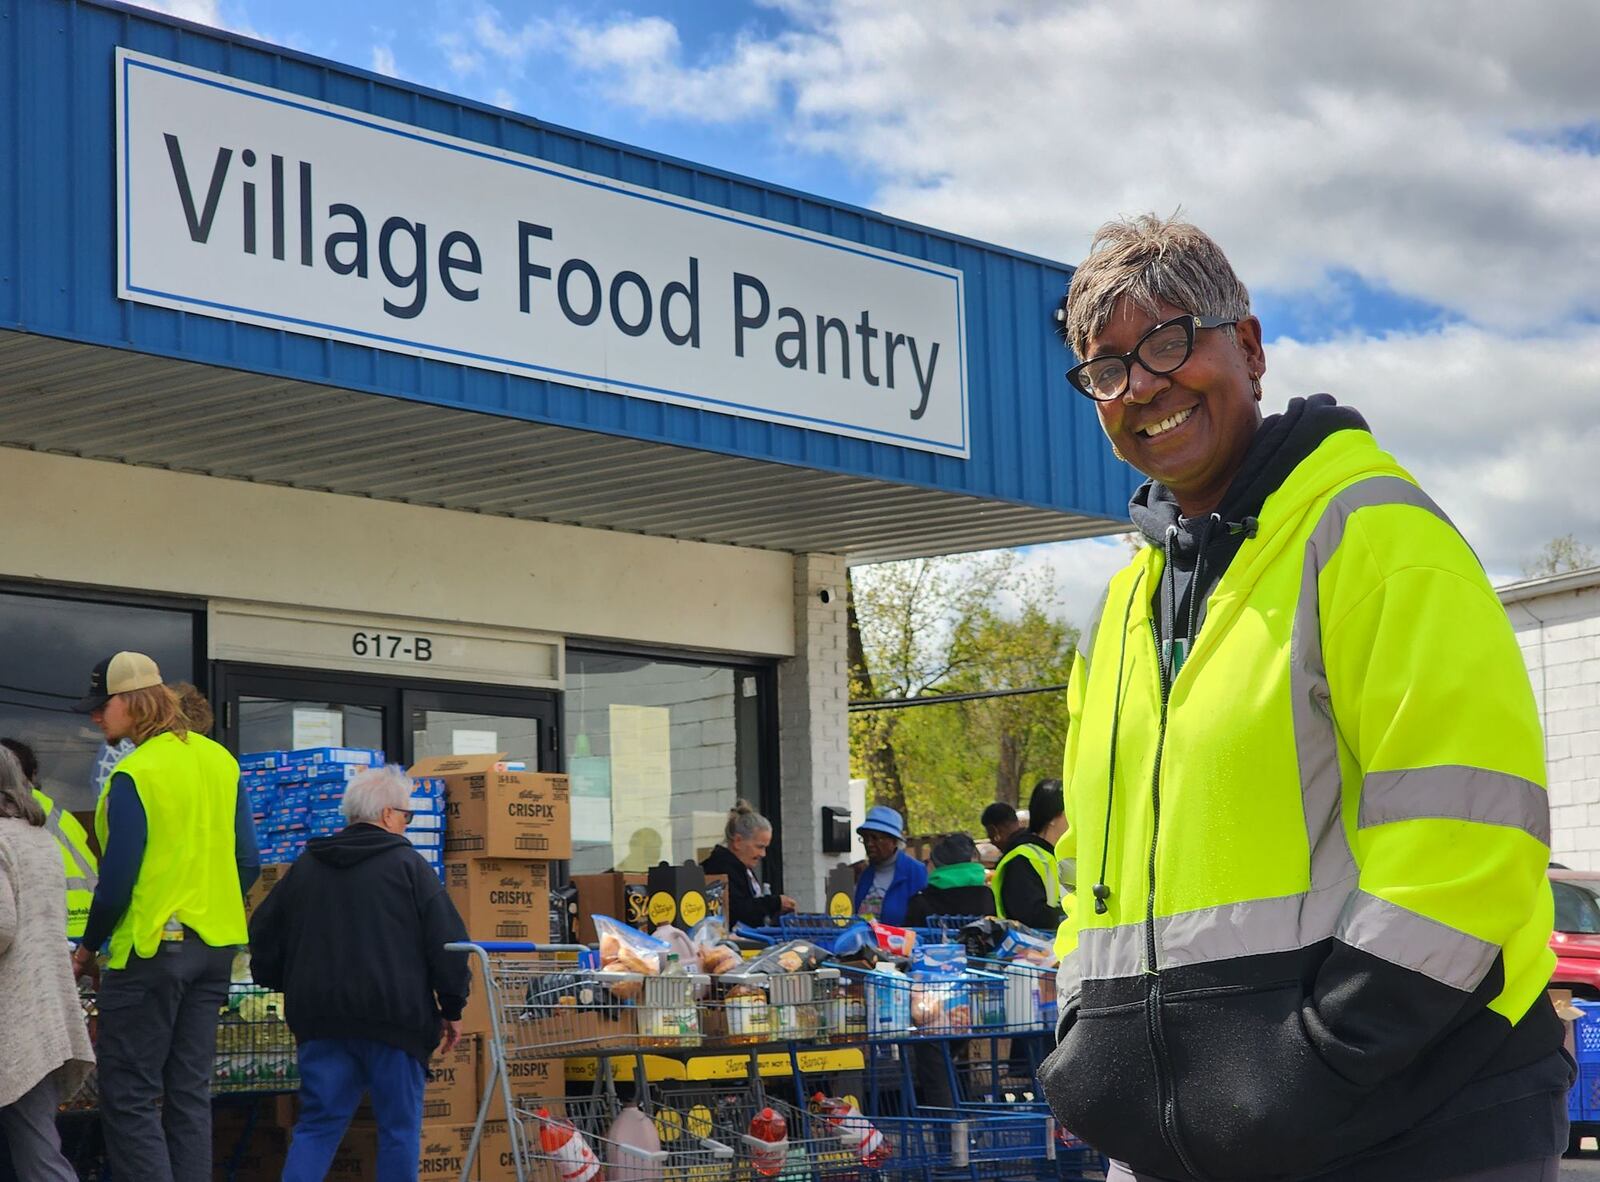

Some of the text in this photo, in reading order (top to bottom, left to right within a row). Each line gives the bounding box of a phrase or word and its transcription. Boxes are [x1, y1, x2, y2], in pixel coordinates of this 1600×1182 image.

[163, 132, 941, 421] Village Food Pantry
[351, 631, 434, 663] 617-B
[508, 802, 554, 818] CRISPIX
[489, 890, 533, 905] CRISPIX
